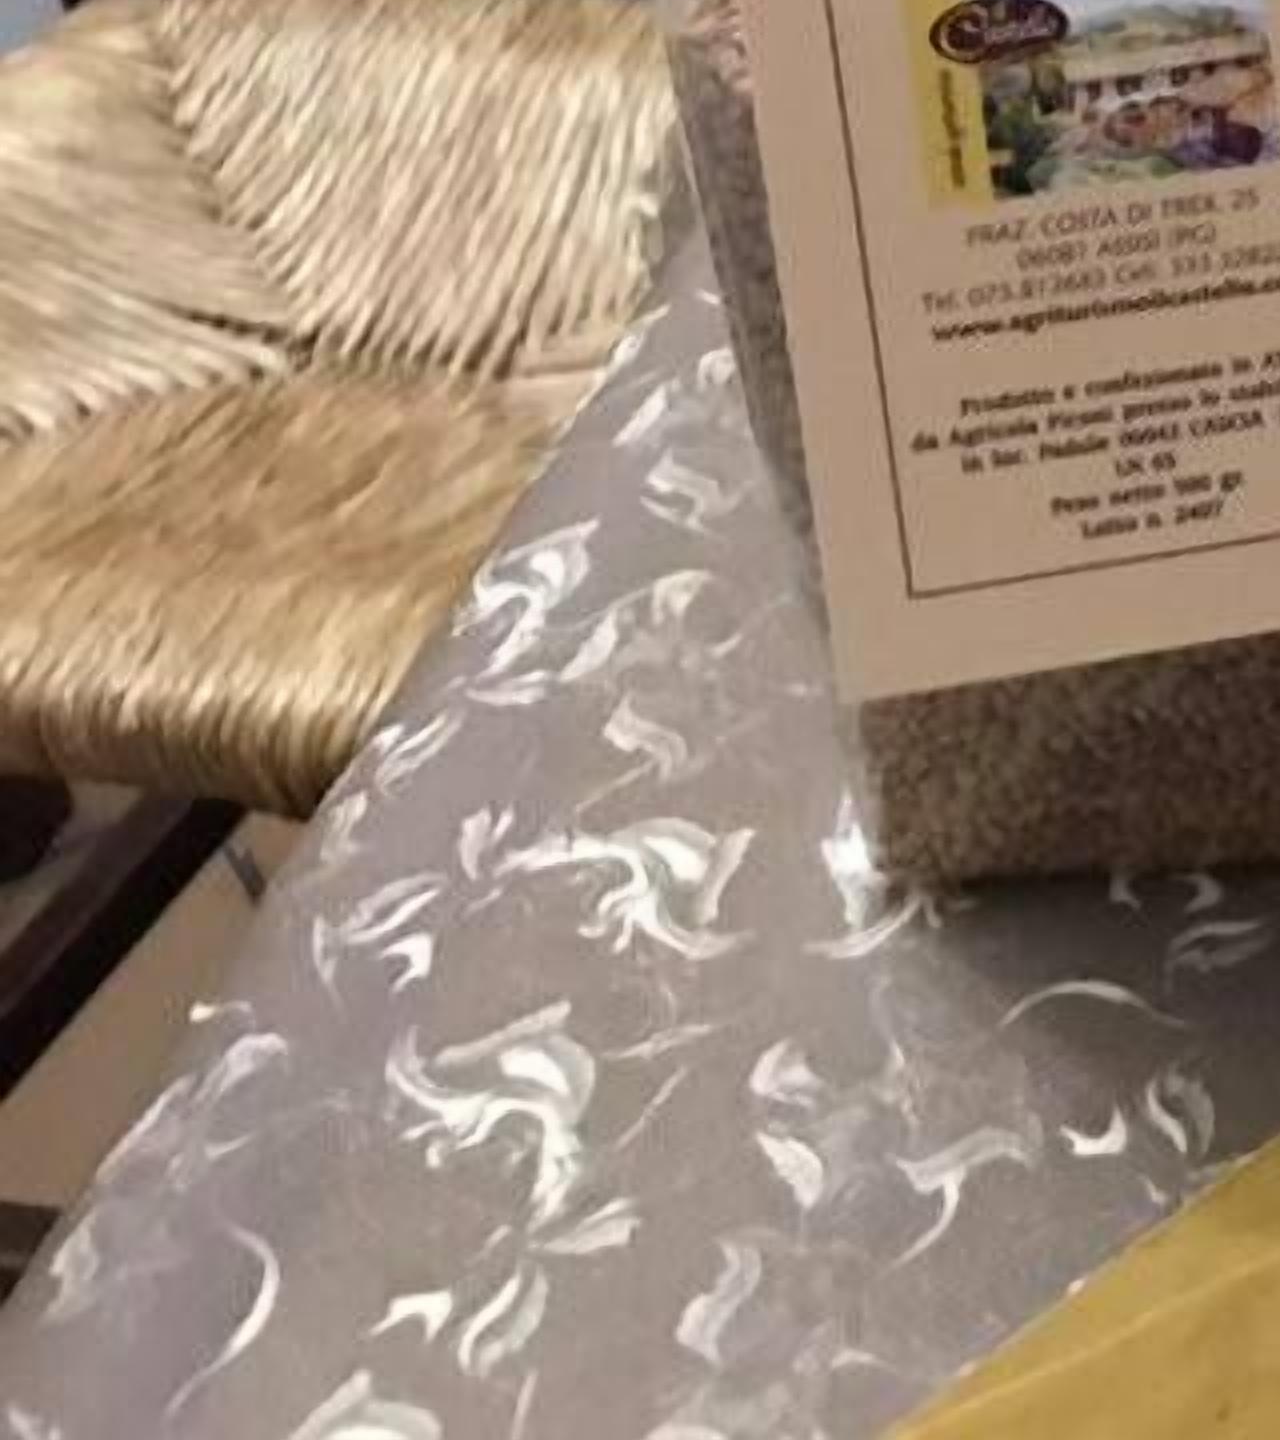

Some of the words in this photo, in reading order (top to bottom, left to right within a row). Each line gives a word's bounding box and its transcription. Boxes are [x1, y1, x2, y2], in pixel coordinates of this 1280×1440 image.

[1039, 205, 1118, 237] COSTA
[1127, 201, 1152, 226] DI
[1096, 227, 1160, 257] ASSISI
